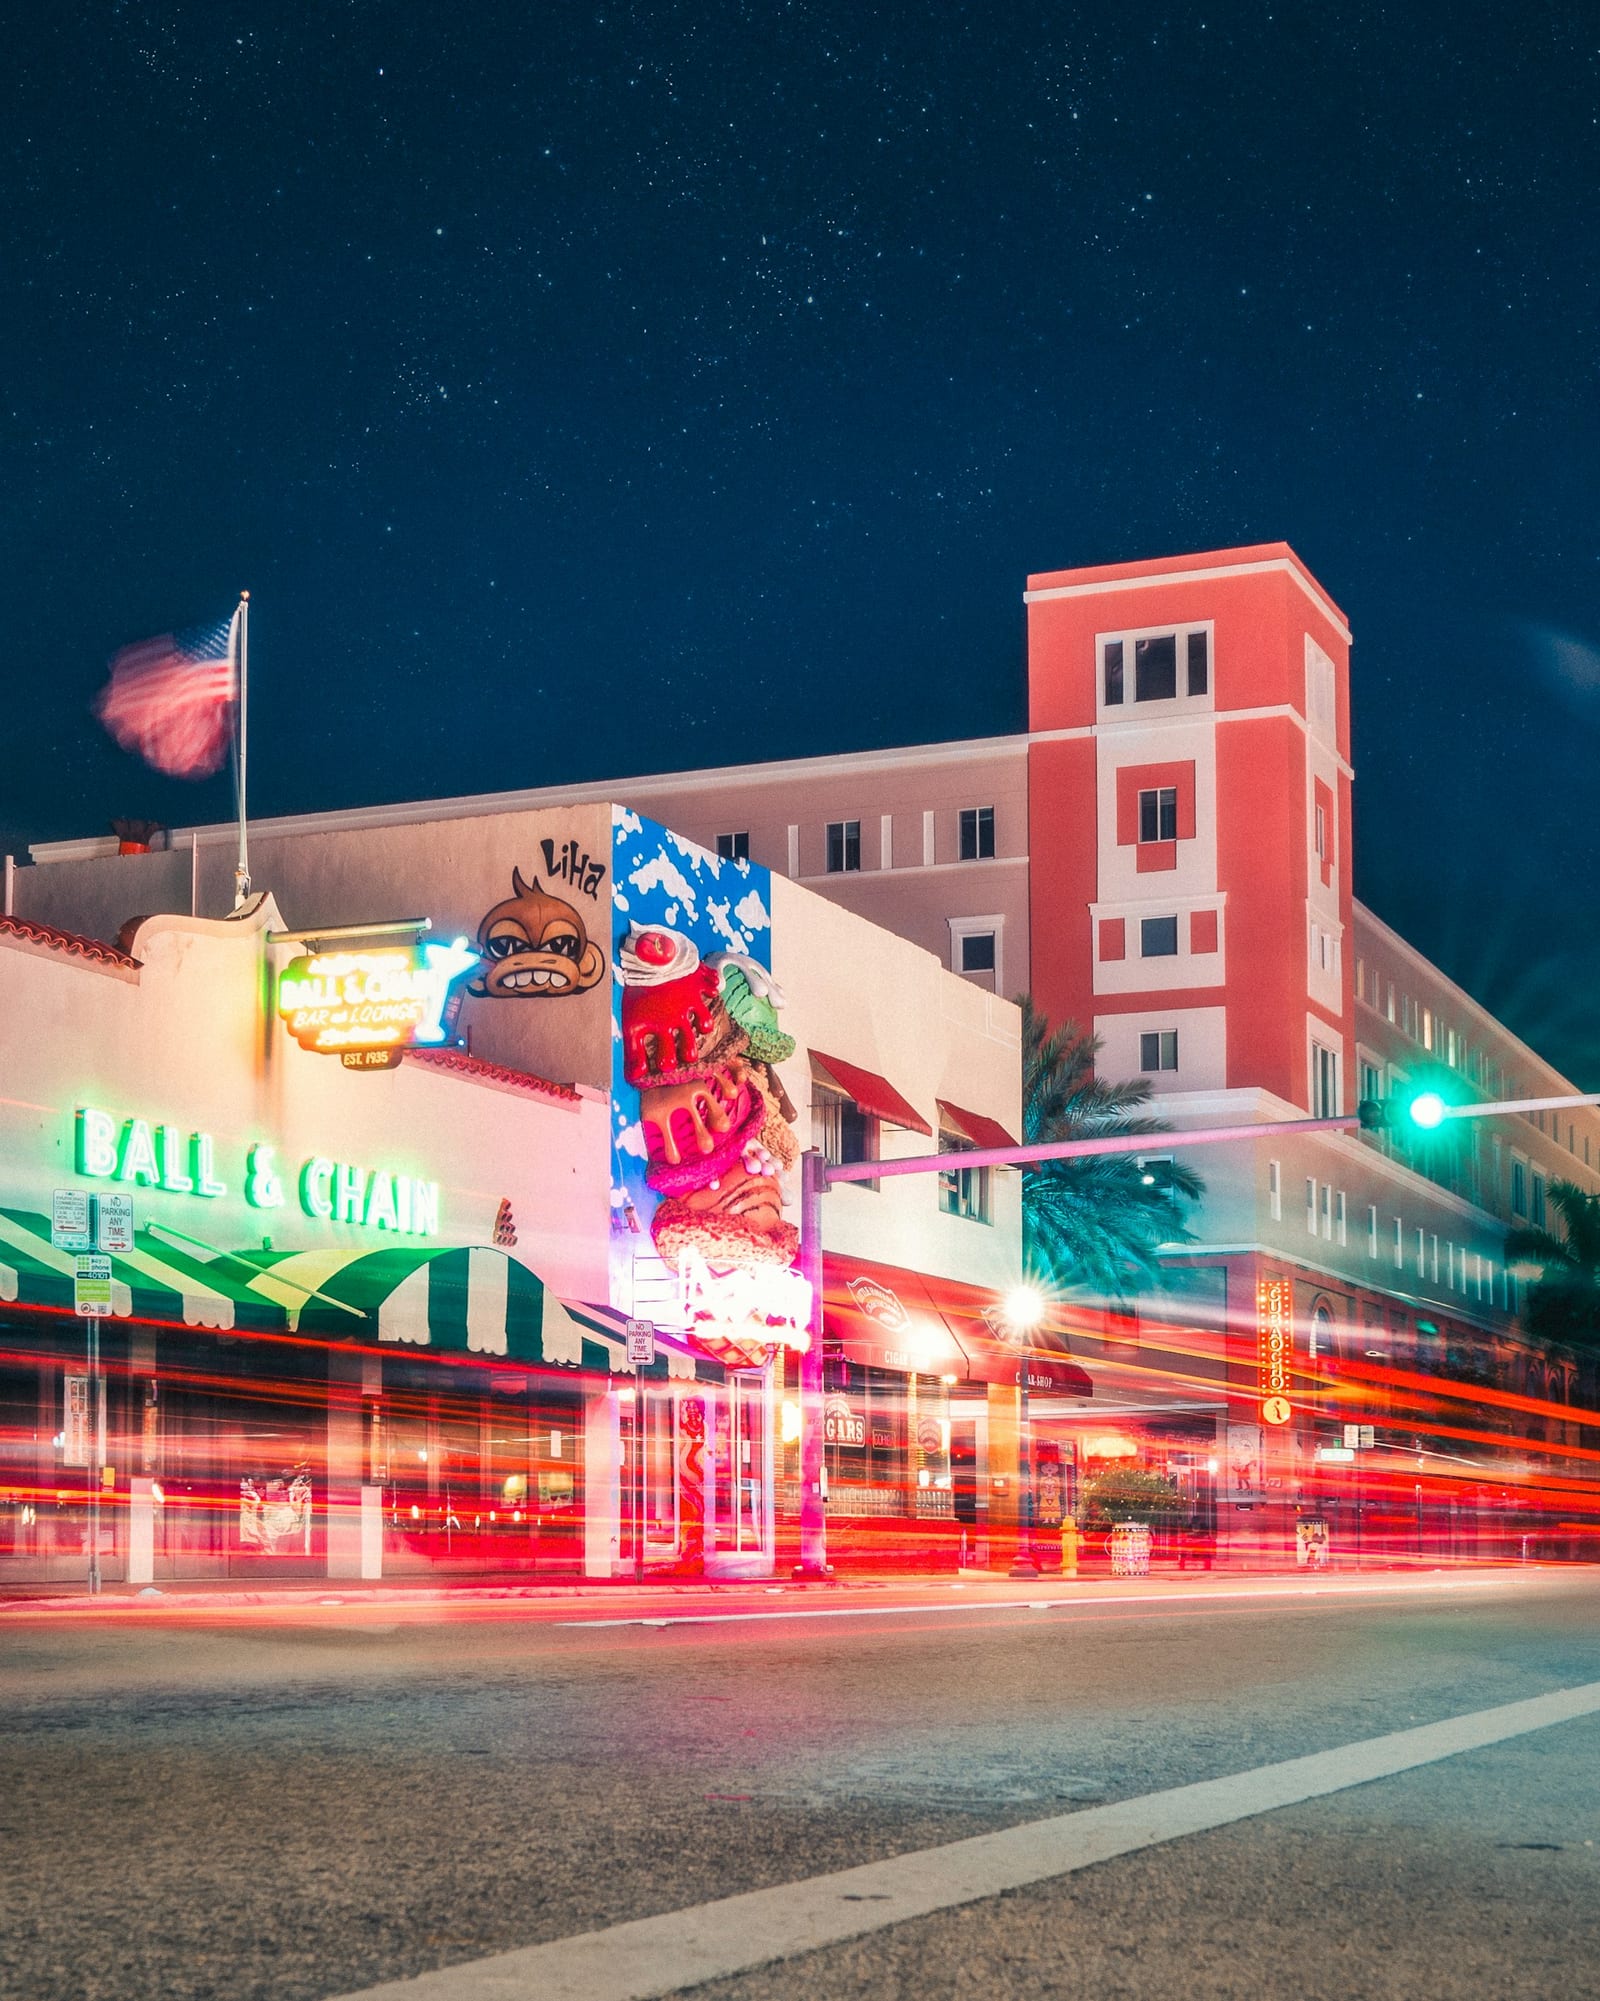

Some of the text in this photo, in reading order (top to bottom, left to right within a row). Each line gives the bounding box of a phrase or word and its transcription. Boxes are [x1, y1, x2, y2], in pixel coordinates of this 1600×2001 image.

[344, 975, 366, 1003] &
[294, 1010, 328, 1027] BAR
[343, 1051, 389, 1066] EST. 1935
[75, 1108, 438, 1236] BALL & CHAIN
[111, 1198, 121, 1206] NO
[101, 1207, 130, 1216] PARKING
[109, 1217, 122, 1226] ANY
[108, 1227, 125, 1236] TIME
[635, 1323, 645, 1331] NO
[629, 1330, 651, 1338] PARKING
[826, 1418, 863, 1443] GARS
